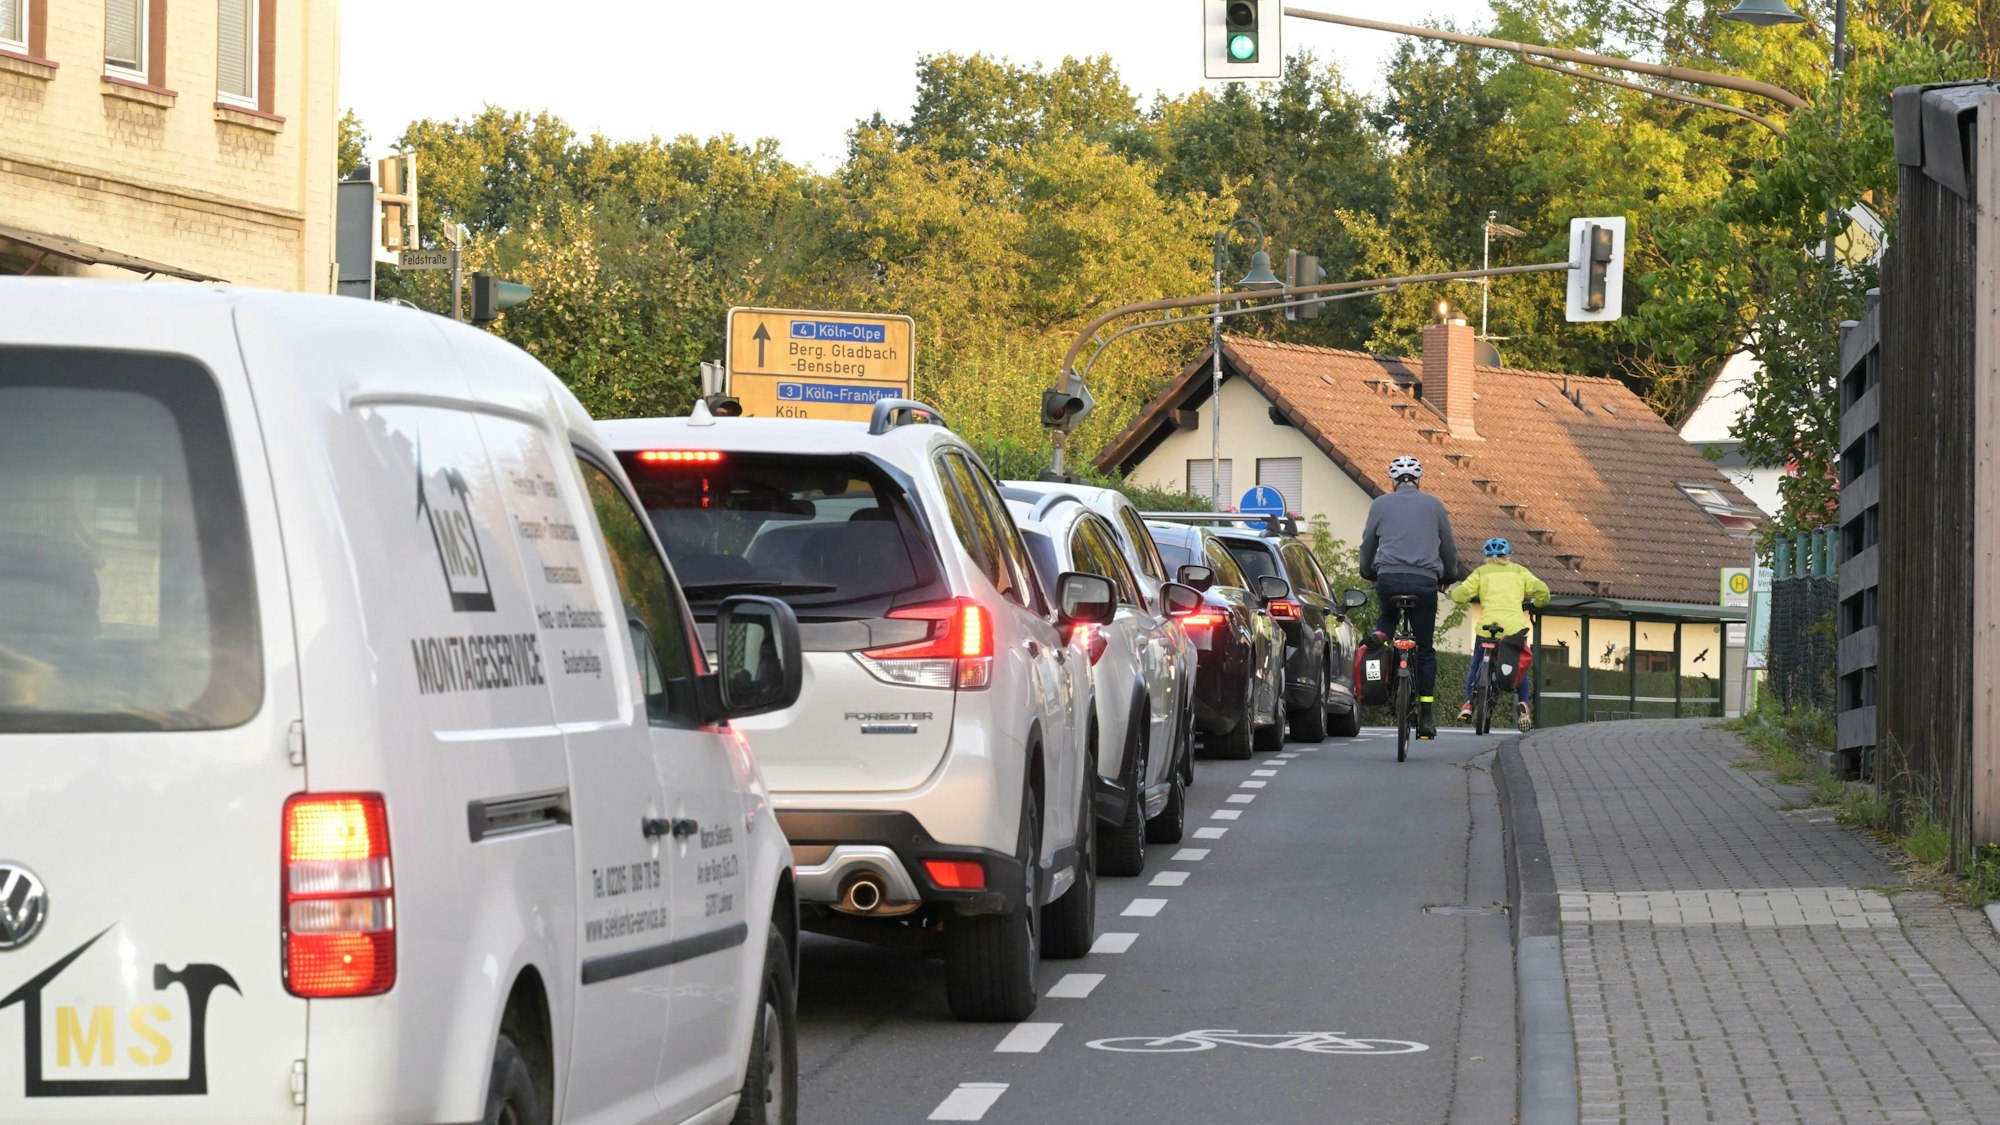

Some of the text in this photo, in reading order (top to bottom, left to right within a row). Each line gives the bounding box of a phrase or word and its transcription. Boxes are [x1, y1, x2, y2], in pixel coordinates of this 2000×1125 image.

[402, 254, 447, 265] Feldstraße
[800, 324, 881, 342] 4 Köln-Olpe
[789, 342, 897, 360] Berg. Gladbach
[791, 358, 865, 377] -Bensberg
[786, 386, 899, 401] 3 Köln-Frankfurt
[776, 405, 807, 419] Köln
[433, 510, 479, 577] MS
[411, 633, 544, 694] MONTAGESERVICE
[844, 711, 934, 721] FORESTER
[55, 1002, 174, 1068] MS
